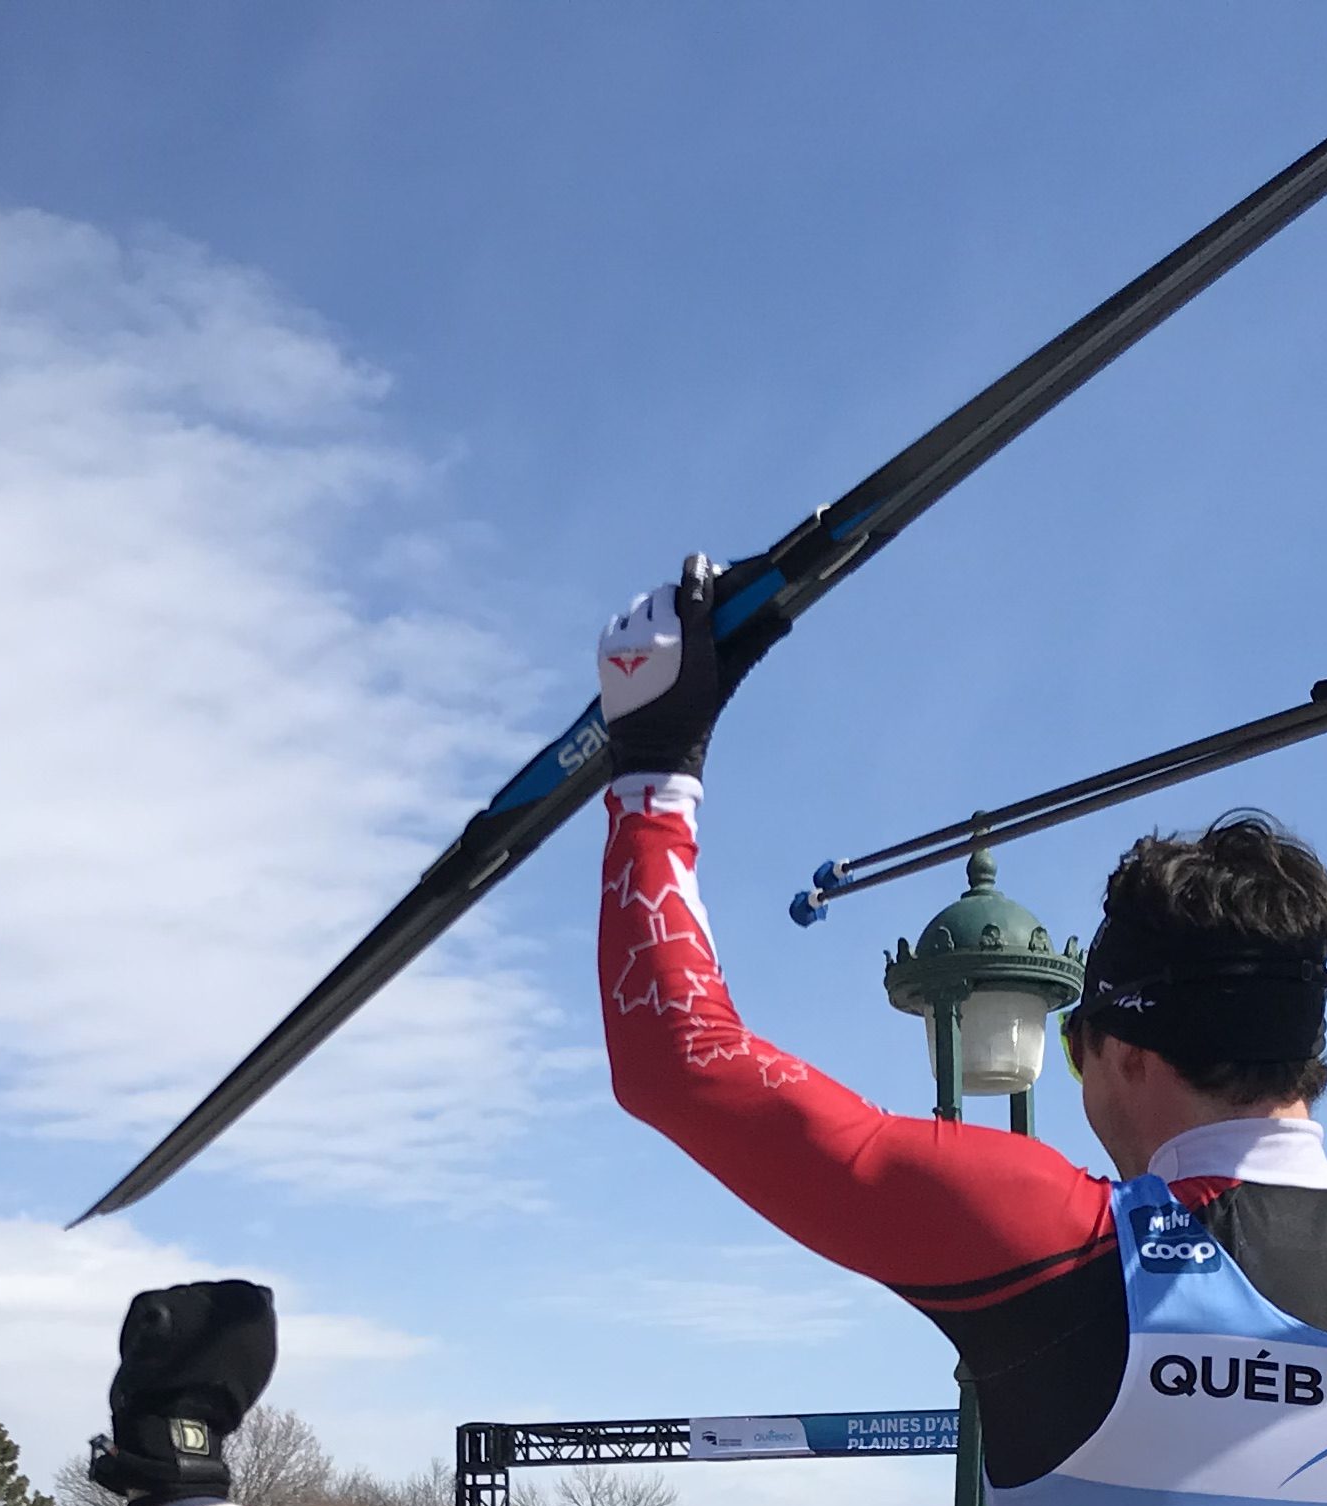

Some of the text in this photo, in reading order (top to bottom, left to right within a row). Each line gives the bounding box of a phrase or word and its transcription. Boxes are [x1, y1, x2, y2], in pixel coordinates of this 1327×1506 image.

[1141, 1242, 1216, 1264] coop
[847, 1417, 922, 1435] PLAINES
[846, 1435, 910, 1450] PLAINS
[913, 1434, 935, 1449] OF
